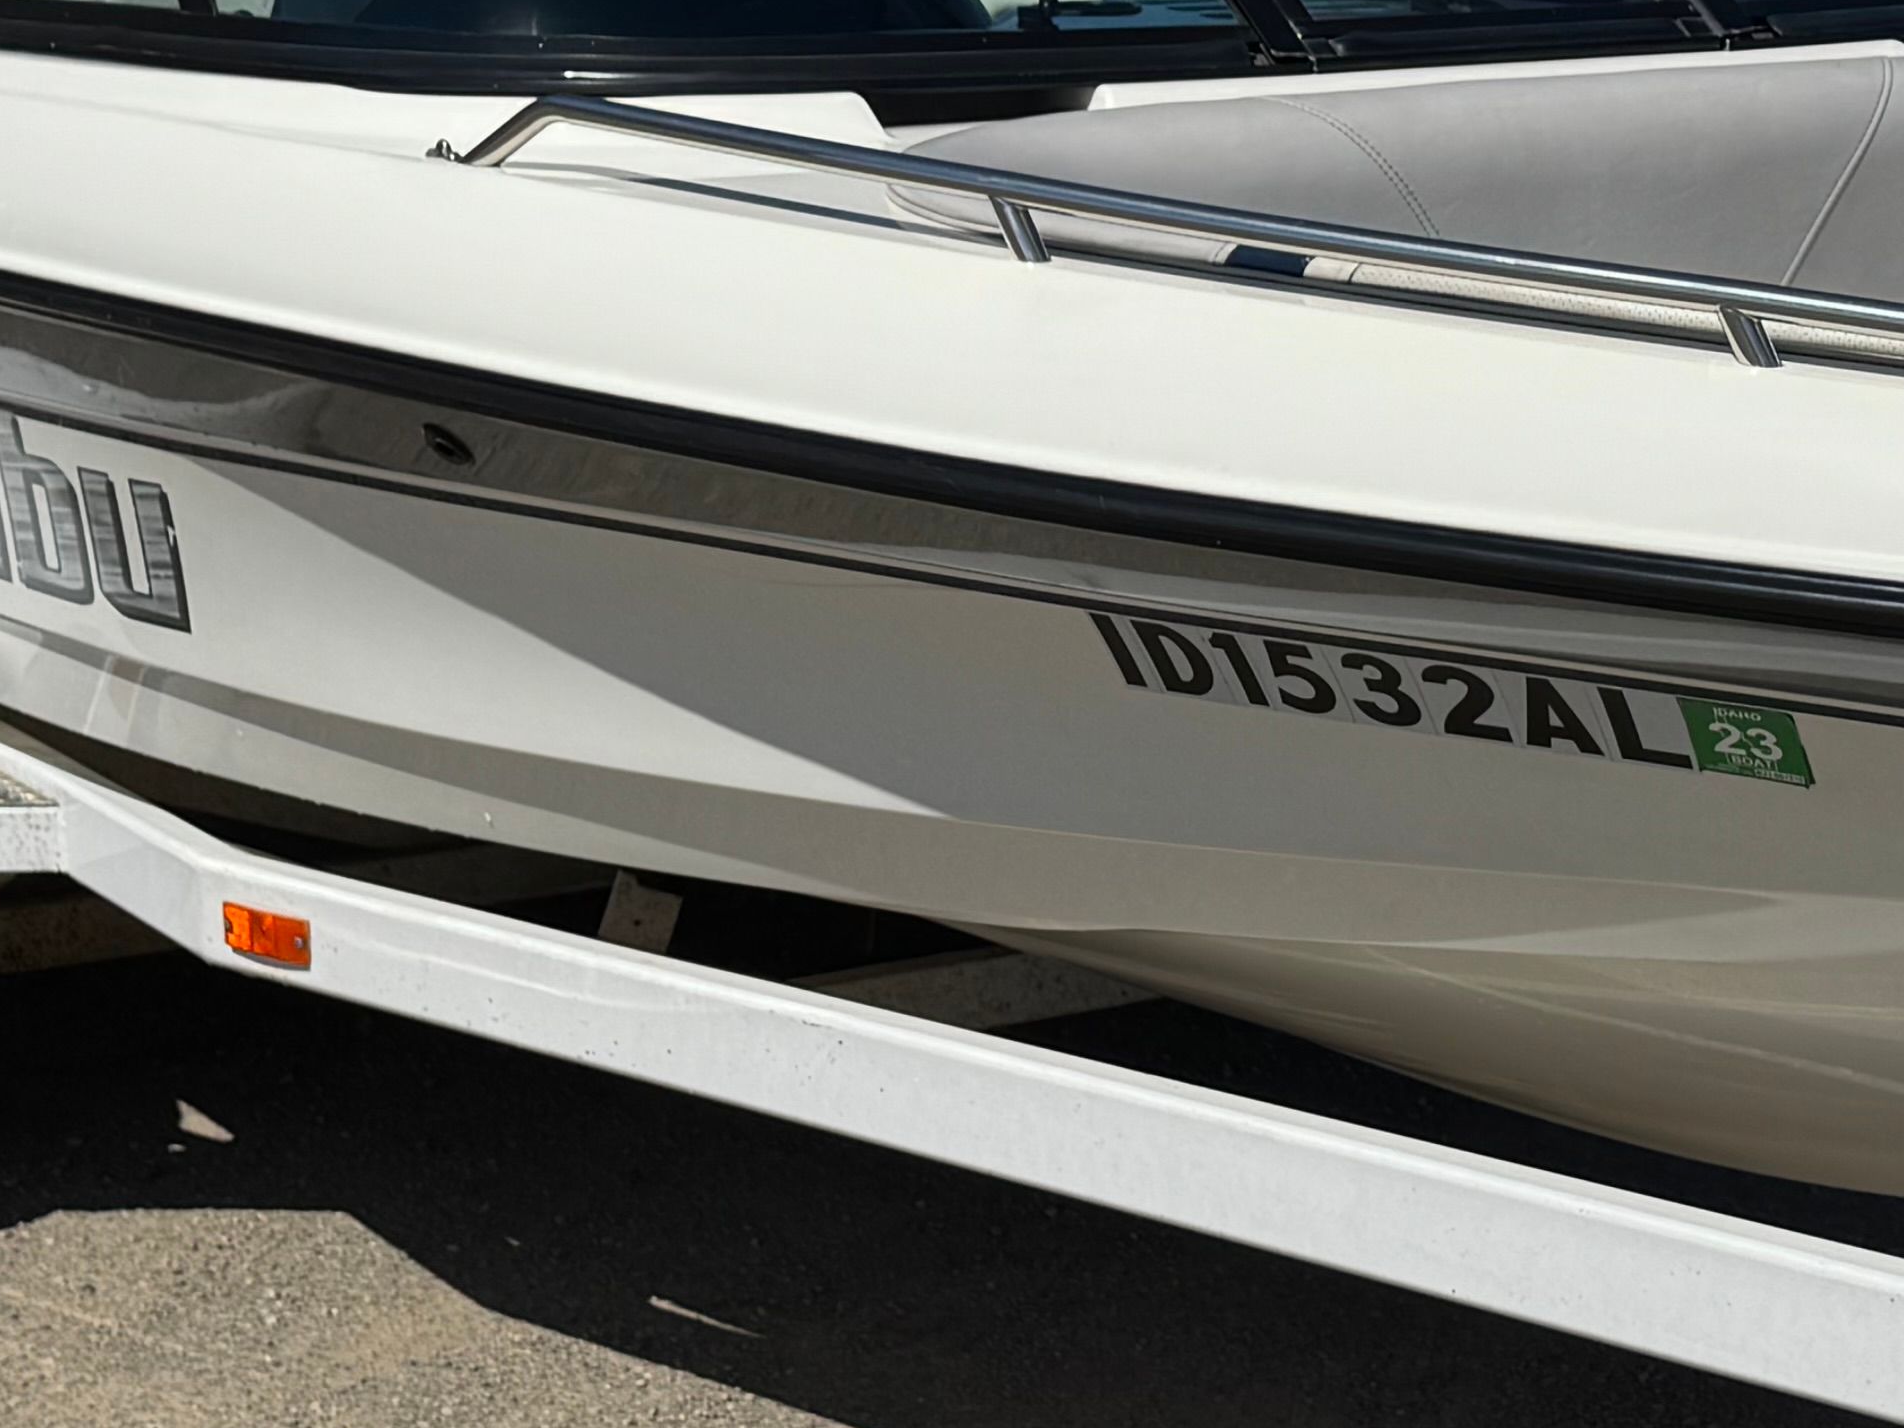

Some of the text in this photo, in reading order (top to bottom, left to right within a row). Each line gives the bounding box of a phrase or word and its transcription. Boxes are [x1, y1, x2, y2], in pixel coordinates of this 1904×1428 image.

[1088, 612, 1693, 770] ID1532AL
[1713, 707, 1762, 721] IDAHO
[1709, 722, 1783, 761] 23
